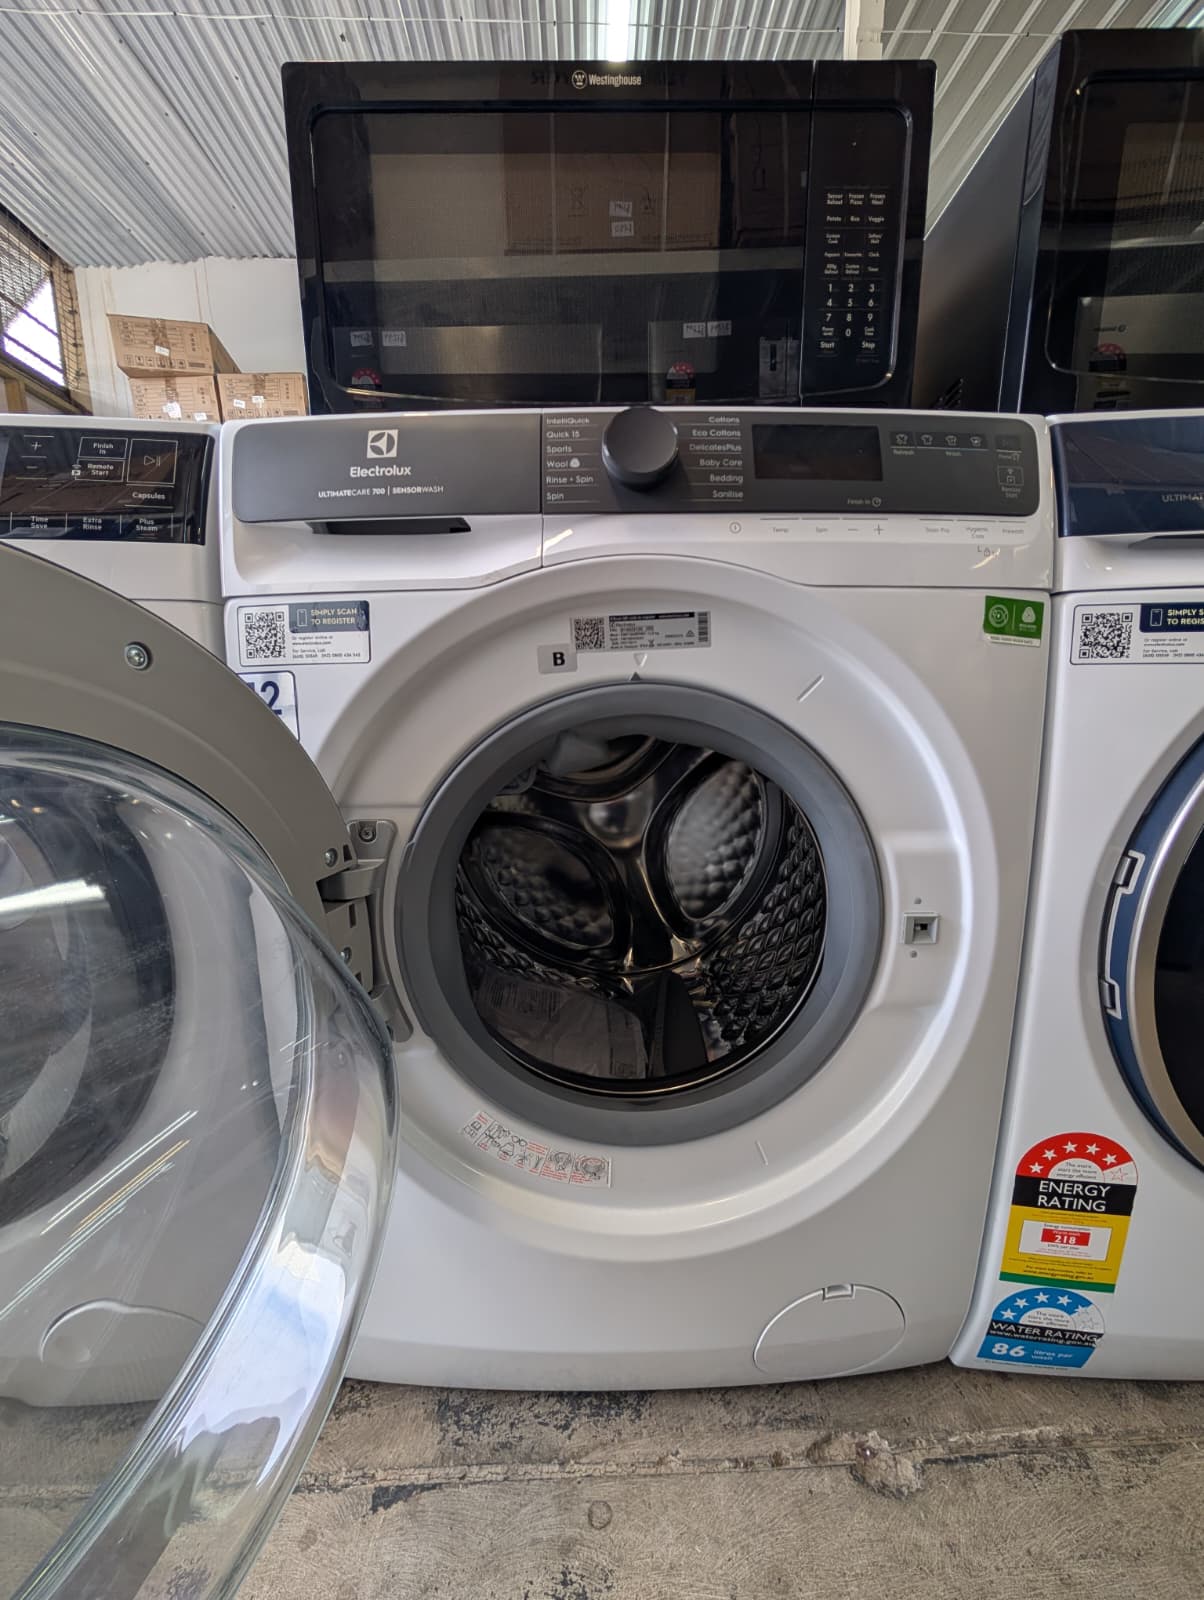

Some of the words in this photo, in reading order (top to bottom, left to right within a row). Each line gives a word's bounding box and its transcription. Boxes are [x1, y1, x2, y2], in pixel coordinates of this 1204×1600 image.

[588, 74, 642, 87] Westinghouse
[848, 283, 854, 292] 2
[869, 283, 875, 292] 3
[827, 298, 832, 306] 4
[847, 298, 853, 307] 5
[867, 298, 874, 307] 6
[825, 313, 832, 322] 7
[846, 313, 852, 322] 8
[867, 313, 873, 322] 9
[845, 328, 852, 337] 0
[820, 341, 835, 349] Start
[862, 340, 875, 350] Stop
[546, 416, 589, 425] IntelliQuick
[708, 416, 740, 424] Cottons
[546, 431, 570, 439] Quick
[692, 429, 708, 437] Eco
[709, 429, 741, 437] Cottons
[93, 442, 114, 450] Finish
[546, 445, 572, 453] Sports
[689, 443, 742, 451] DelicatesPlus
[87, 463, 114, 471] Remote
[546, 460, 569, 468] Wool
[700, 458, 721, 468] Baby
[722, 458, 743, 466] Care
[350, 465, 412, 478] Electrolux
[546, 475, 568, 484] Rinse
[576, 475, 594, 484] Spin
[709, 474, 744, 483] Bedding
[132, 492, 165, 500] Capsules
[318, 487, 371, 499] ULTIMATECARE
[372, 487, 386, 496] 700
[392, 485, 444, 495] SENSORWASH
[546, 492, 564, 500] Spin
[712, 490, 744, 498] Sanitise
[139, 518, 154, 526] Plus
[311, 608, 335, 616] SIMPLY
[322, 617, 356, 625] REGISTER
[552, 651, 566, 667] B
[1039, 1180, 1111, 1198] ENERGY
[1037, 1194, 1107, 1213] RATING
[1055, 1234, 1077, 1245] 218
[992, 1321, 1041, 1336] WATER
[1045, 1330, 1098, 1342] RATING
[992, 1343, 1025, 1357] 86
